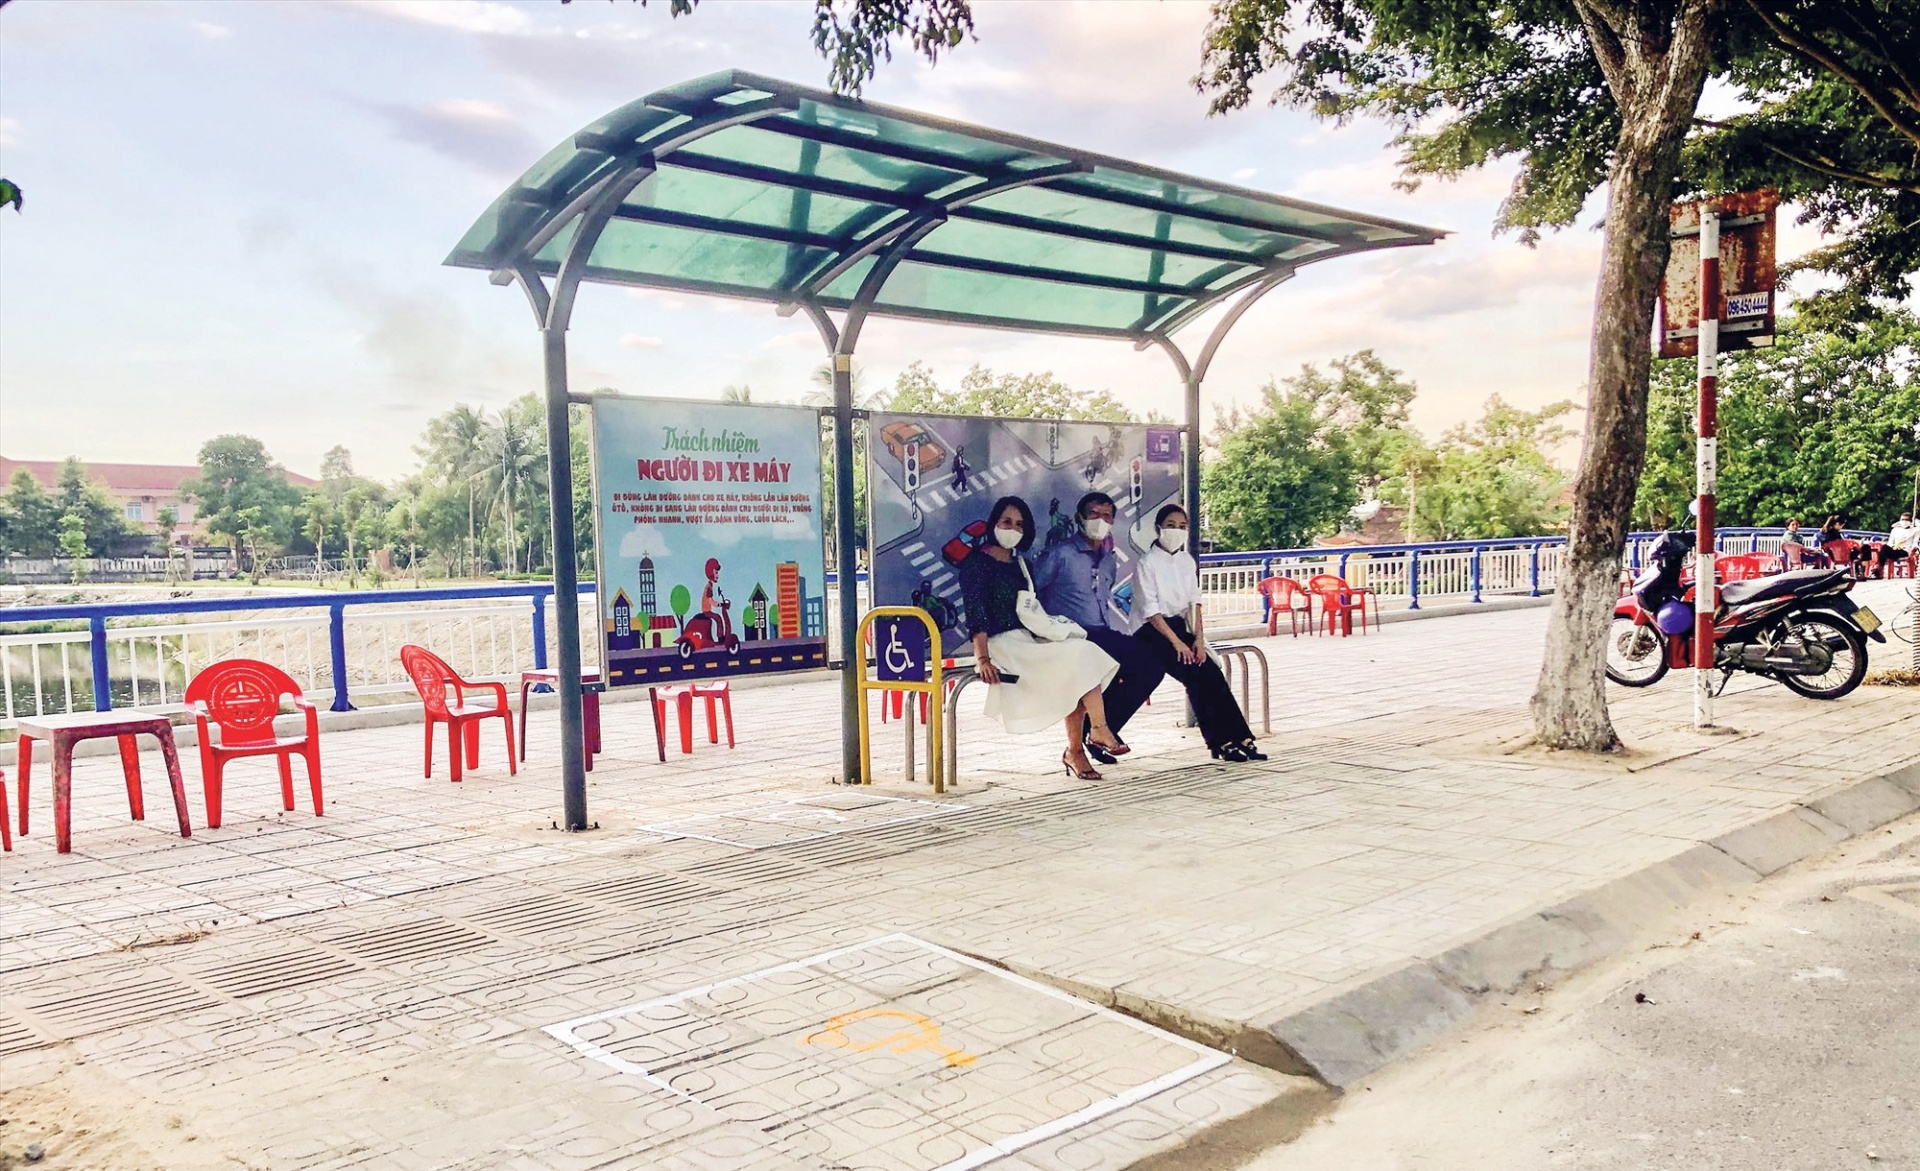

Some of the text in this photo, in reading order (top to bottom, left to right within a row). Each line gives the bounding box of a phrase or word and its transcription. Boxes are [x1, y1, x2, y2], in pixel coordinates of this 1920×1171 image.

[662, 426, 760, 459] Trách nhiệm
[637, 454, 792, 482] NGƯỜI ĐI XE MÁY
[643, 492, 657, 501] LÀN
[716, 494, 724, 502] XE
[742, 492, 762, 502] KHÔNG
[777, 492, 788, 502] LÀN
[631, 502, 654, 512] KHÔNG
[684, 503, 696, 512] LÀN
[753, 503, 771, 512] NGƯỜI
[792, 504, 812, 512] KHÔNG
[634, 514, 657, 523] PHÓNG
